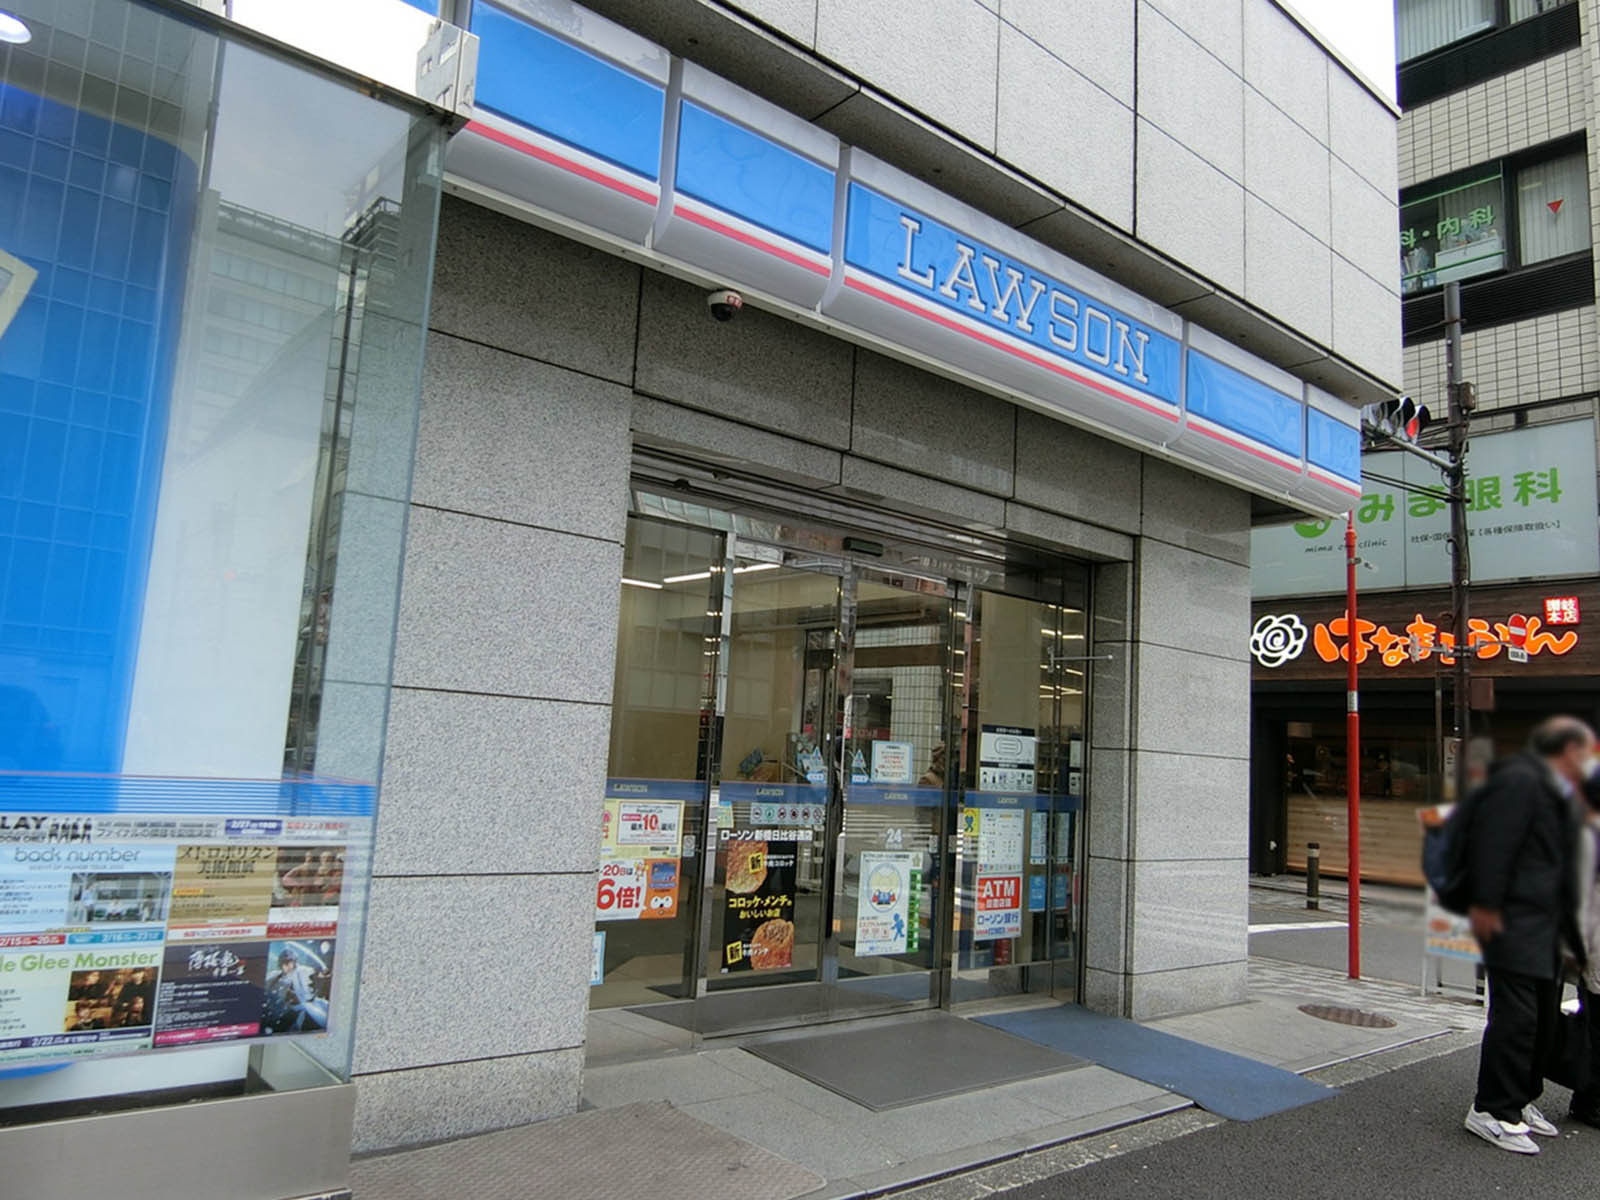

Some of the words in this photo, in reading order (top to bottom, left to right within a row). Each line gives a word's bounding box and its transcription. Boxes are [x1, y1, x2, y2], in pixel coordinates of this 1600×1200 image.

[897, 213, 1150, 386] LAWSON
[1357, 467, 1562, 524] みま眼科
[886, 828, 903, 842] 24
[15, 847, 60, 862] back
[67, 847, 139, 861] number
[180, 846, 275, 861] メトロポリタン
[603, 864, 633, 876] 20日は
[597, 878, 641, 910] 6倍!
[982, 880, 1016, 898] ATM
[977, 913, 1019, 925] ローソン銀行
[20, 953, 70, 970] Glee
[74, 951, 159, 969] Monster
